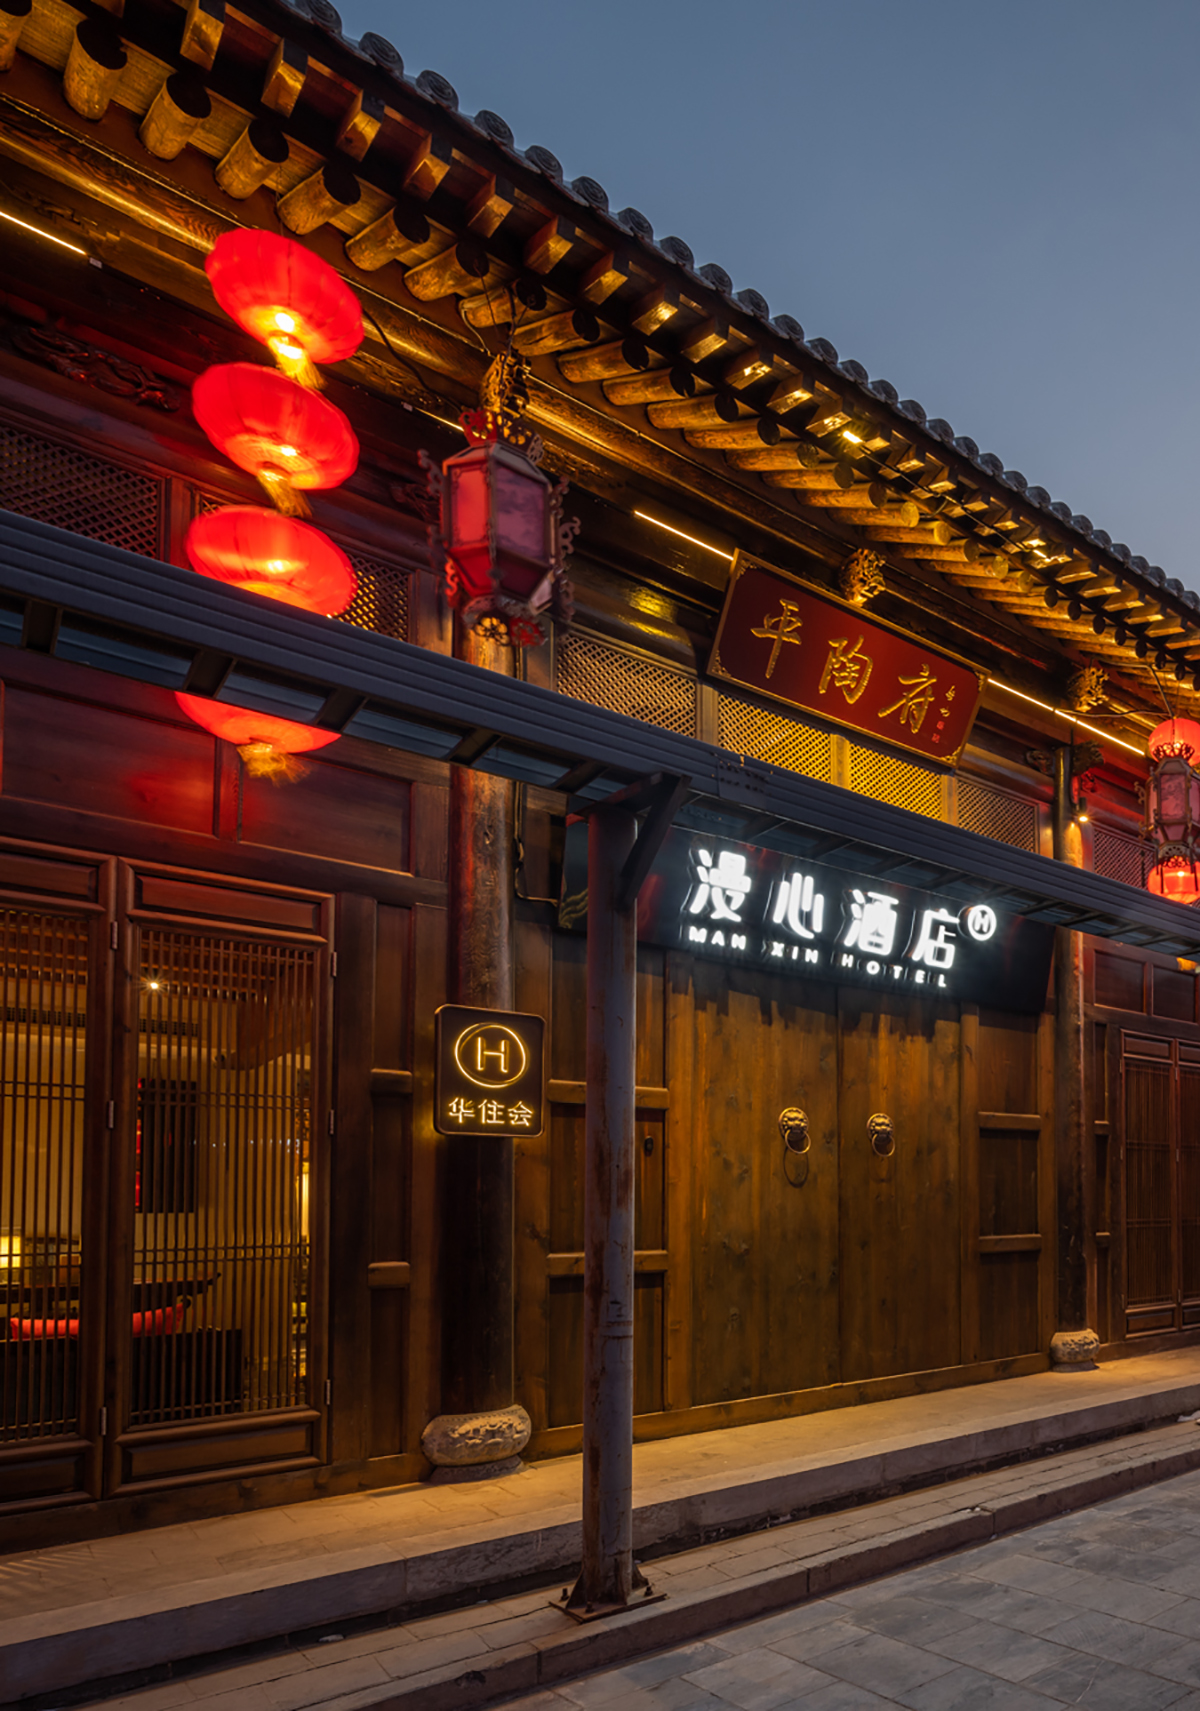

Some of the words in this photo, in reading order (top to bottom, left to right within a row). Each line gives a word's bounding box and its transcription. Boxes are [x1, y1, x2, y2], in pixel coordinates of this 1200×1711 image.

[750, 598, 938, 734] 平陶府
[688, 848, 961, 969] 漫心酒店
[688, 926, 747, 950] MAN
[770, 941, 819, 964] XIN
[841, 953, 947, 988] HOTEL
[448, 1096, 534, 1127] 华住会
